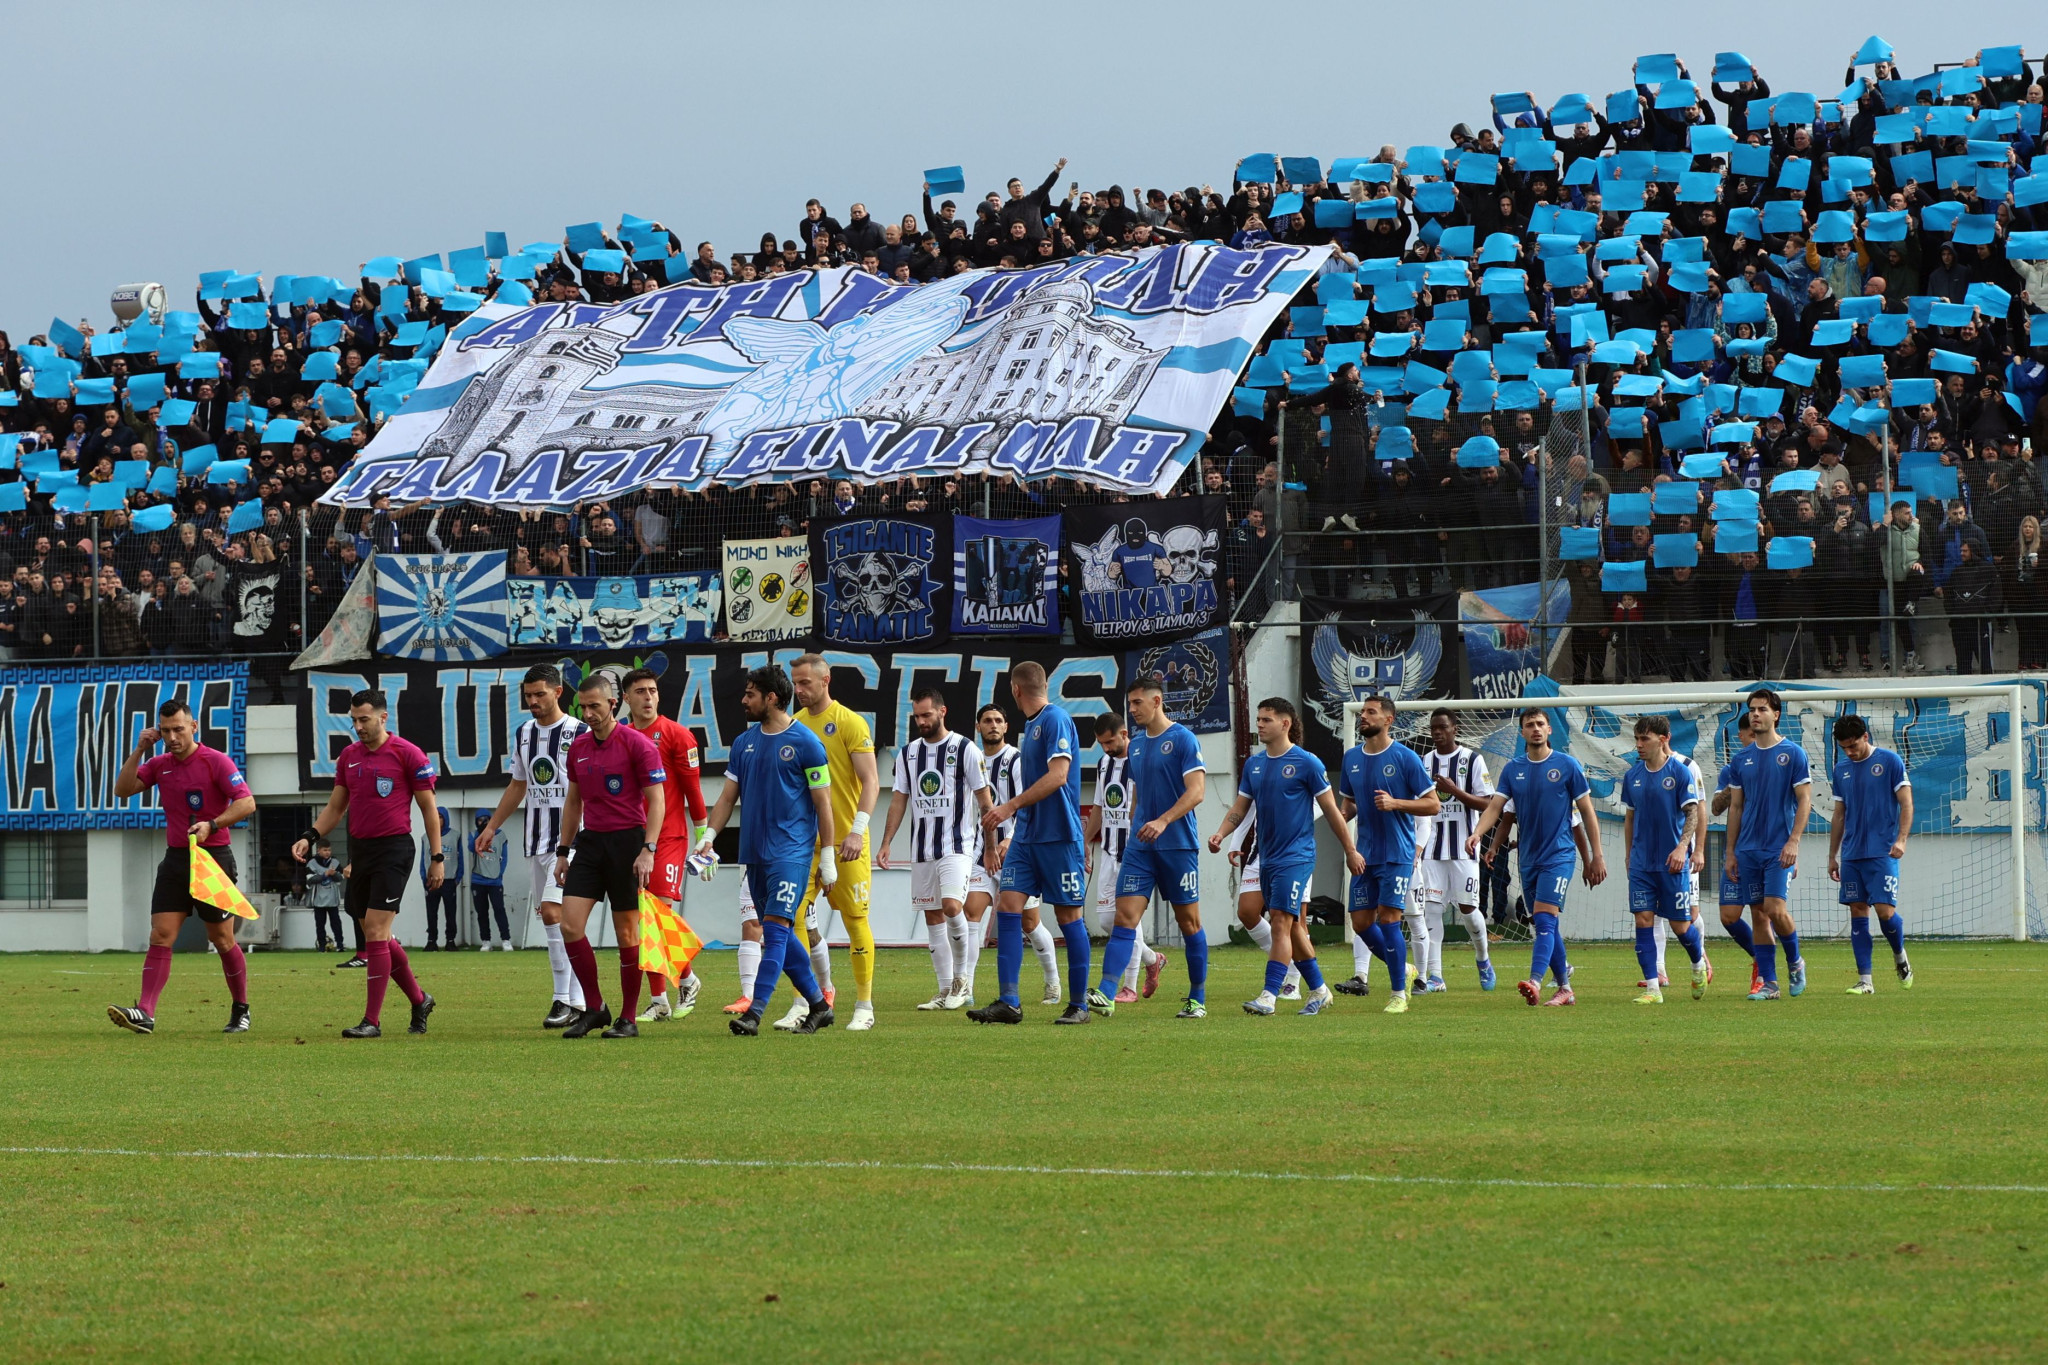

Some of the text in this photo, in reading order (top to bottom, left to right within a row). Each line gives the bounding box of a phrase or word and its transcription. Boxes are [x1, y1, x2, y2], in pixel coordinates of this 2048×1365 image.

[333, 434, 711, 504] ΓΑΛΑΖΙΑ
[718, 417, 997, 478] ΕΙΝΑΙ
[824, 520, 934, 563] TSIGANTE
[963, 598, 1047, 624] ΚΑΠΑΚΛΙ
[1080, 578, 1218, 624] ΝΙΚΑΡΑ
[824, 607, 933, 644] FANATIC
[1093, 611, 1207, 636] ΠΕΤΡΟΥ & ΠΑΥΛΟΥ 3
[528, 787, 566, 798] VENETI
[915, 798, 950, 809] VENETI
[665, 863, 679, 884] 91
[1062, 872, 1080, 892] 55
[1179, 871, 1197, 891] 40
[776, 881, 797, 904] 25
[852, 881, 869, 903] 15
[1290, 880, 1300, 900] 5
[1394, 876, 1409, 896] 33
[1413, 887, 1425, 903] 19
[1553, 877, 1568, 894] 18
[1884, 876, 1898, 894] 32
[1675, 891, 1690, 910] 22
